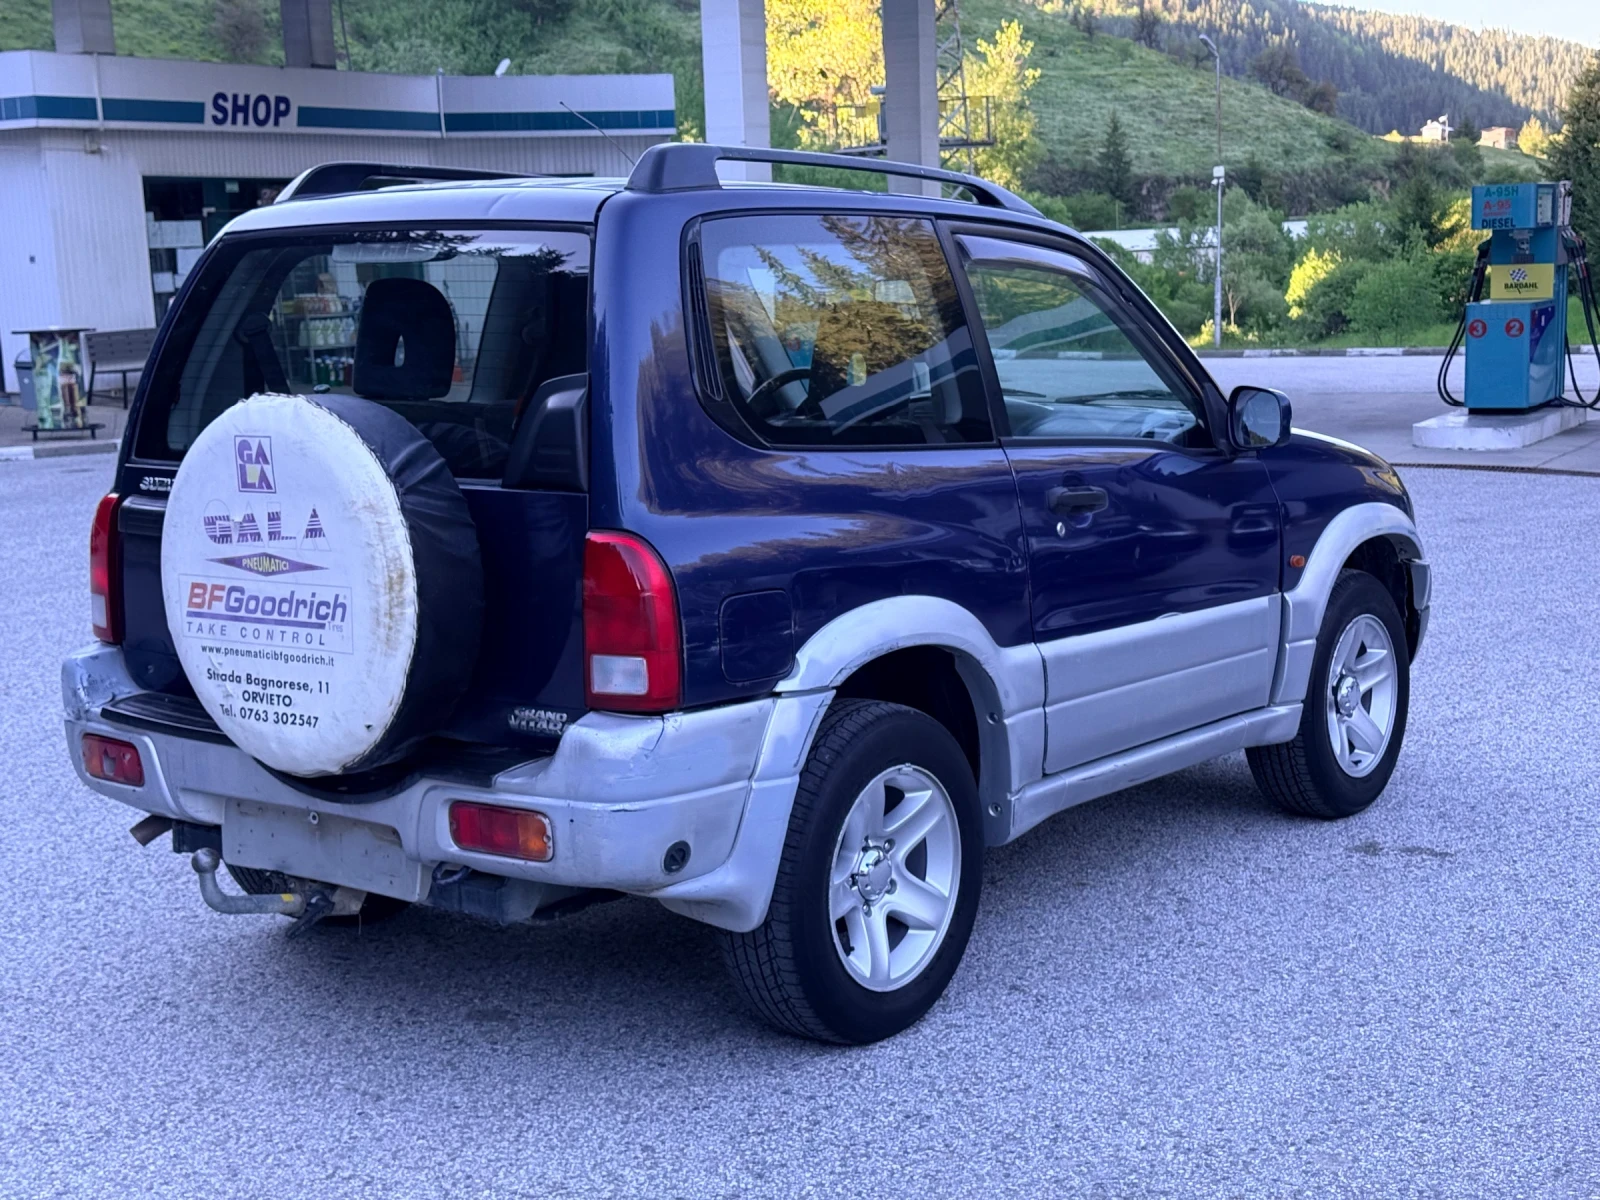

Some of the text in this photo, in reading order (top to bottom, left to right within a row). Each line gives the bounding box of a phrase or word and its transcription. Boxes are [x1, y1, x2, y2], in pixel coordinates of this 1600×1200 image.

[212, 92, 291, 127] SHOP
[1484, 186, 1519, 198] A-95H
[1484, 200, 1512, 210] A-95
[1482, 217, 1516, 229] DIESEL
[1504, 282, 1538, 290] BARDAHL
[1474, 322, 1484, 336] 3
[1510, 321, 1520, 335] 2
[242, 556, 289, 573] PNEUMATICI
[187, 582, 347, 623] BFGoodrich
[186, 621, 326, 646] TAKE CONTROL
[201, 645, 335, 667] www.pneumaticibfgoodrich.it
[207, 668, 330, 694] Strada Bagnorese, 11
[242, 690, 293, 707] ORVIETO
[220, 704, 319, 729] Tel. 0763 302547
[514, 707, 568, 723] GRAND
